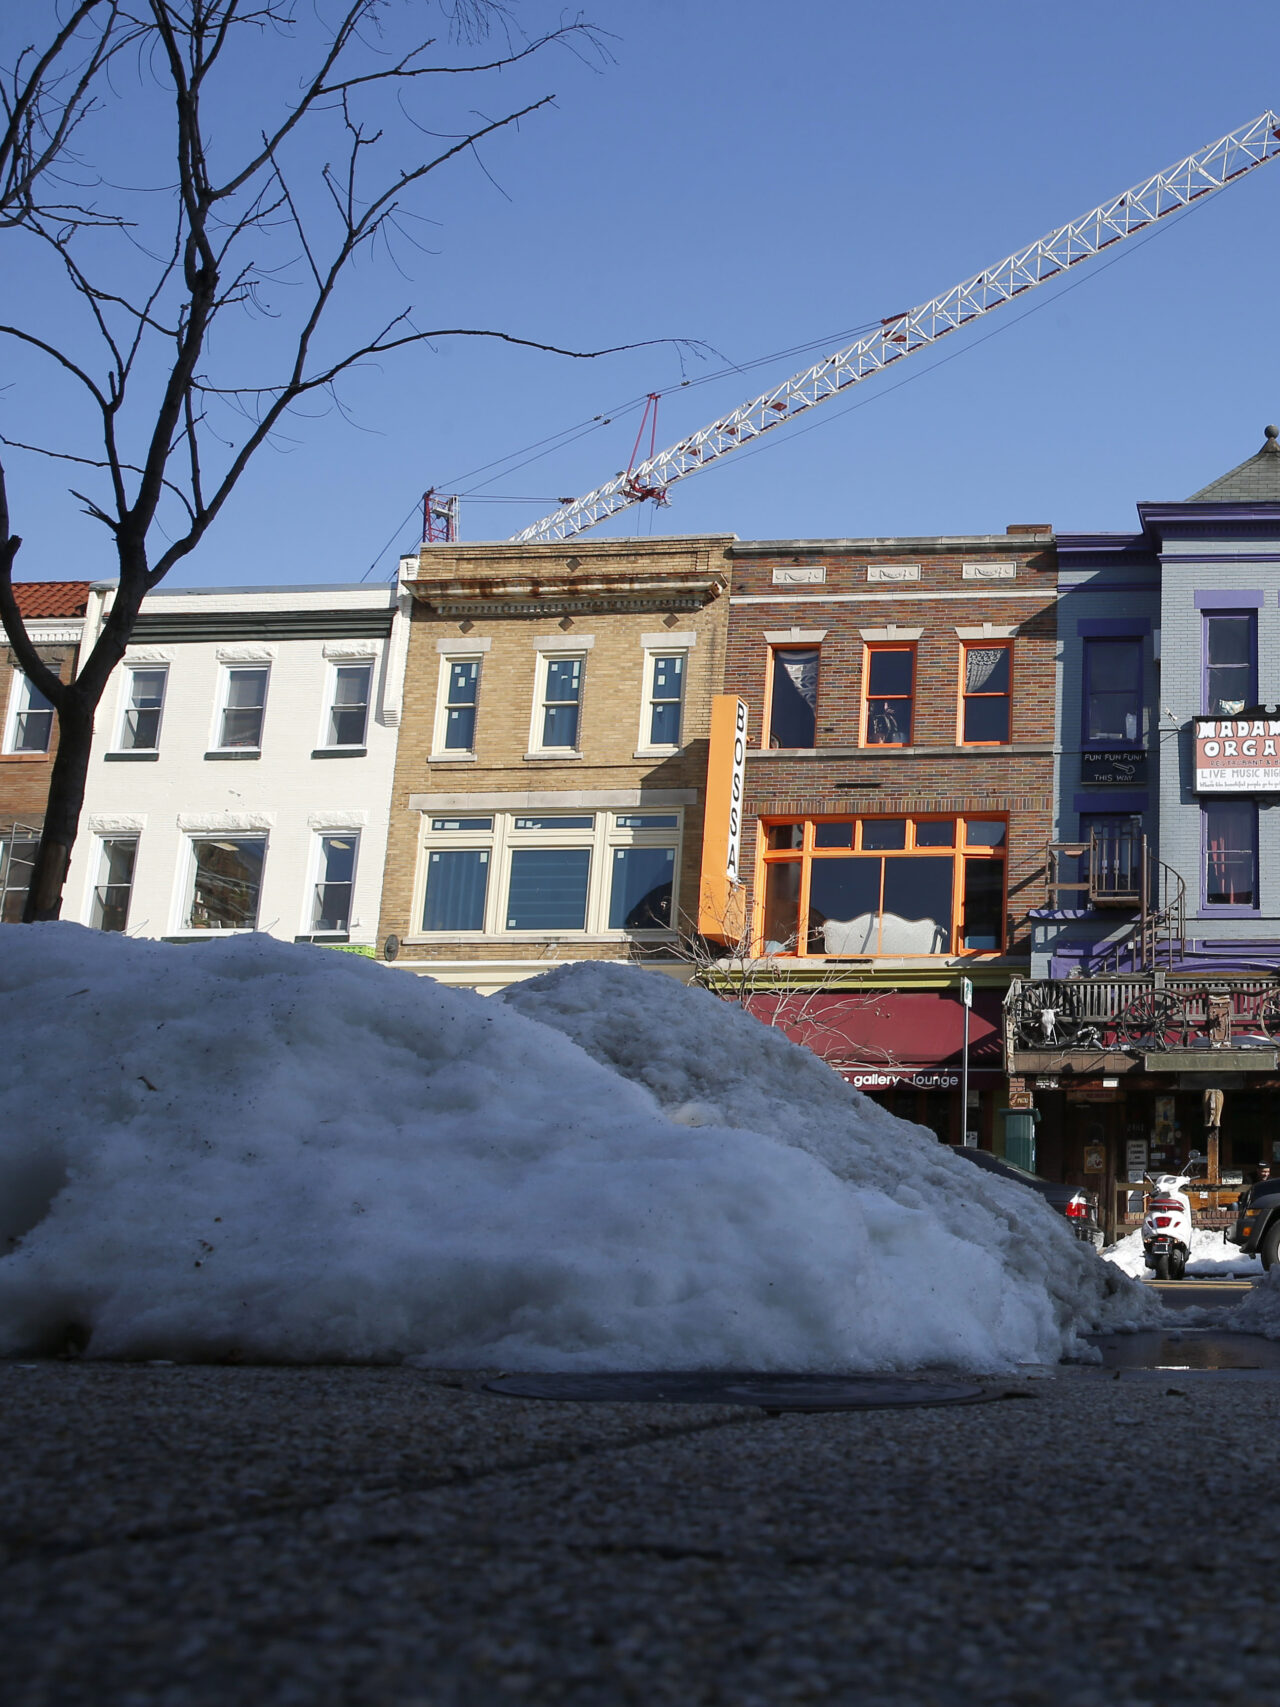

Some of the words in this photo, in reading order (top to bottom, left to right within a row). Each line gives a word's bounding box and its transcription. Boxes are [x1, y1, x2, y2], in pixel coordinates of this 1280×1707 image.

[1084, 753, 1102, 761] FUN
[1104, 753, 1122, 761] FUN
[1094, 774, 1113, 782] THIS
[1201, 769, 1227, 779] LIVE
[1231, 769, 1261, 778] MUSIC
[727, 703, 744, 874] BOSSA
[853, 1073, 900, 1088] gallery
[912, 1073, 958, 1088] lounge
